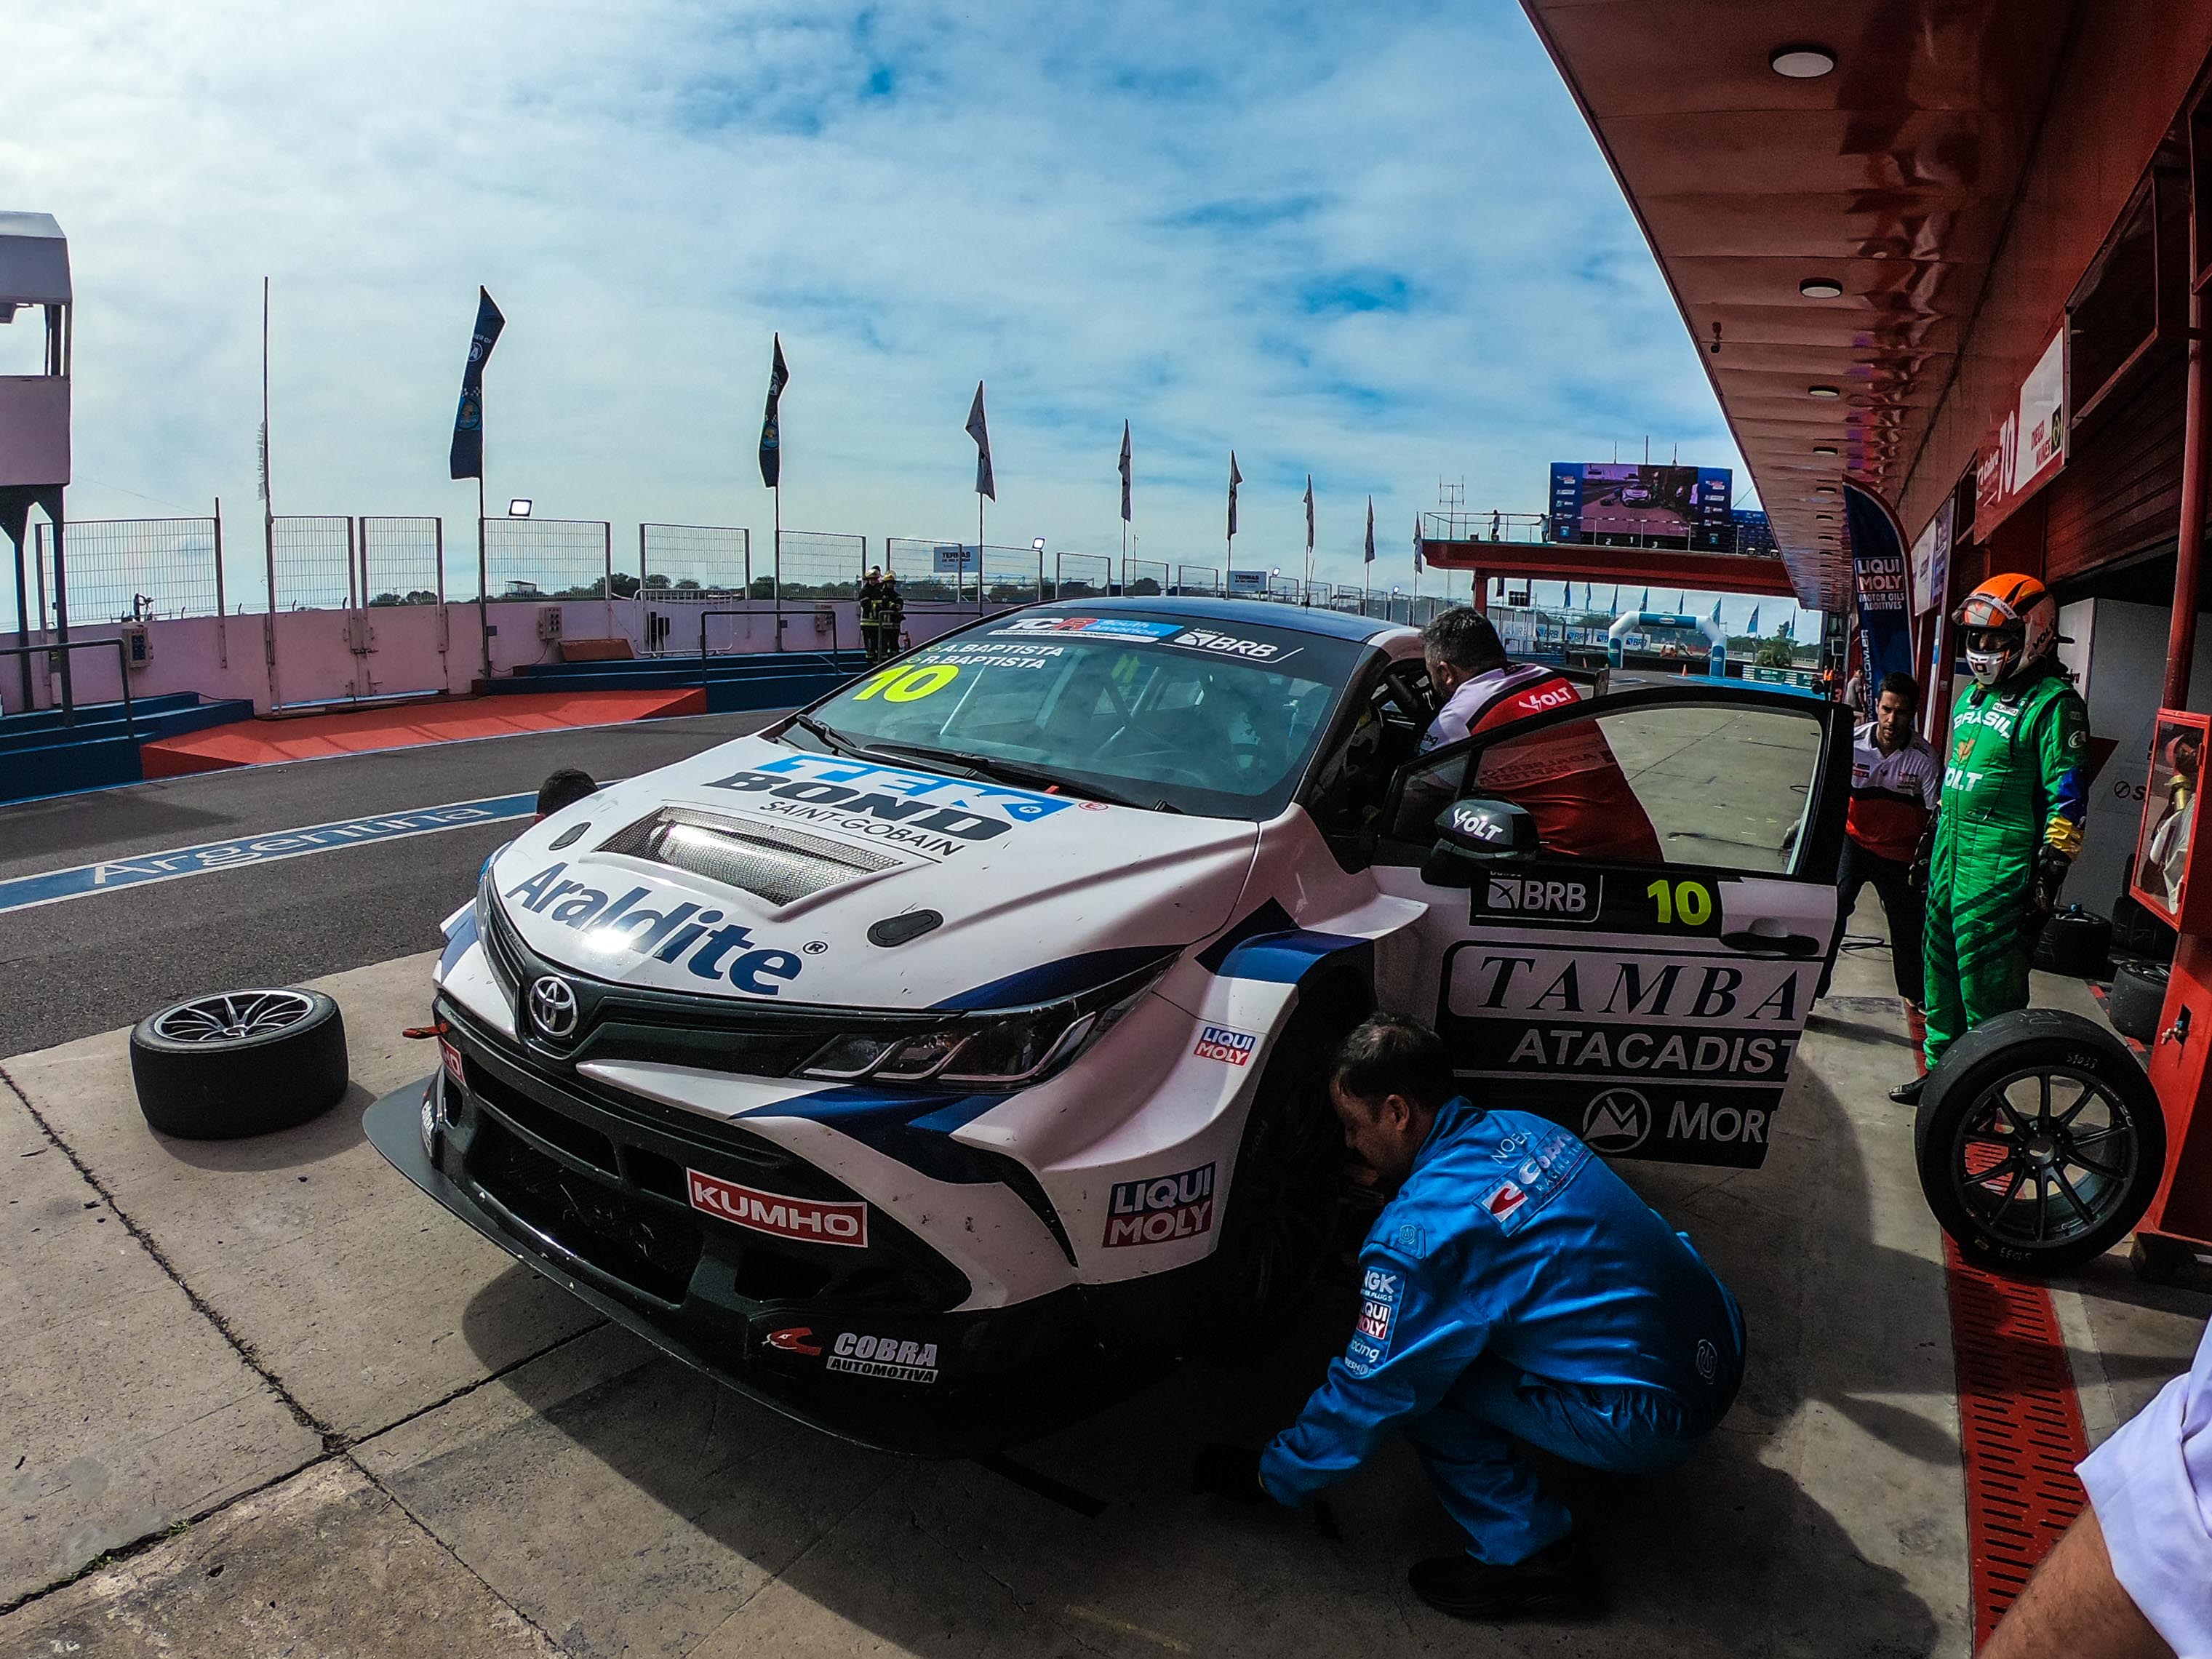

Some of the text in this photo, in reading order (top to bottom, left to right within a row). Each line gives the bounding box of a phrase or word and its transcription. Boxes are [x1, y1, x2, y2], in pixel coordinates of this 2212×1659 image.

[2000, 410, 2015, 502] 10
[1857, 559, 1900, 574] LIQUI
[1858, 575, 1901, 591] MOLY
[1859, 593, 1905, 603] MOTOR OILS
[1864, 601, 1903, 611] ADDITIVES
[1007, 617, 1099, 631] TCR
[1194, 628, 1225, 636] banco
[920, 655, 1047, 669] R.BAPTISTA
[940, 644, 1065, 657] A.BAPTISTA
[1207, 637, 1278, 657] BRB
[853, 665, 959, 703] 10
[1519, 687, 1572, 711] VOLT
[1954, 710, 2012, 739] BRASIL
[700, 772, 1013, 841] BOND
[759, 801, 966, 857] SAINT-GOBAIN
[1453, 807, 1504, 842] VOLT
[93, 807, 492, 884] Argentina
[1523, 881, 1586, 912] BRB
[1647, 879, 1712, 925] 10
[505, 863, 802, 996] Araldite
[1477, 956, 1799, 1020] TAMBA
[1196, 1043, 1250, 1066] MOLY
[1203, 1027, 1255, 1051] LIQUI
[1667, 1100, 1770, 1144] MOR
[1114, 1167, 1211, 1214] LIQUI
[692, 1180, 859, 1236] KUMHO
[1107, 1201, 1213, 1246] MOLY
[834, 1332, 938, 1366] COBRA
[830, 1359, 938, 1383] AUTOMOTIVA
